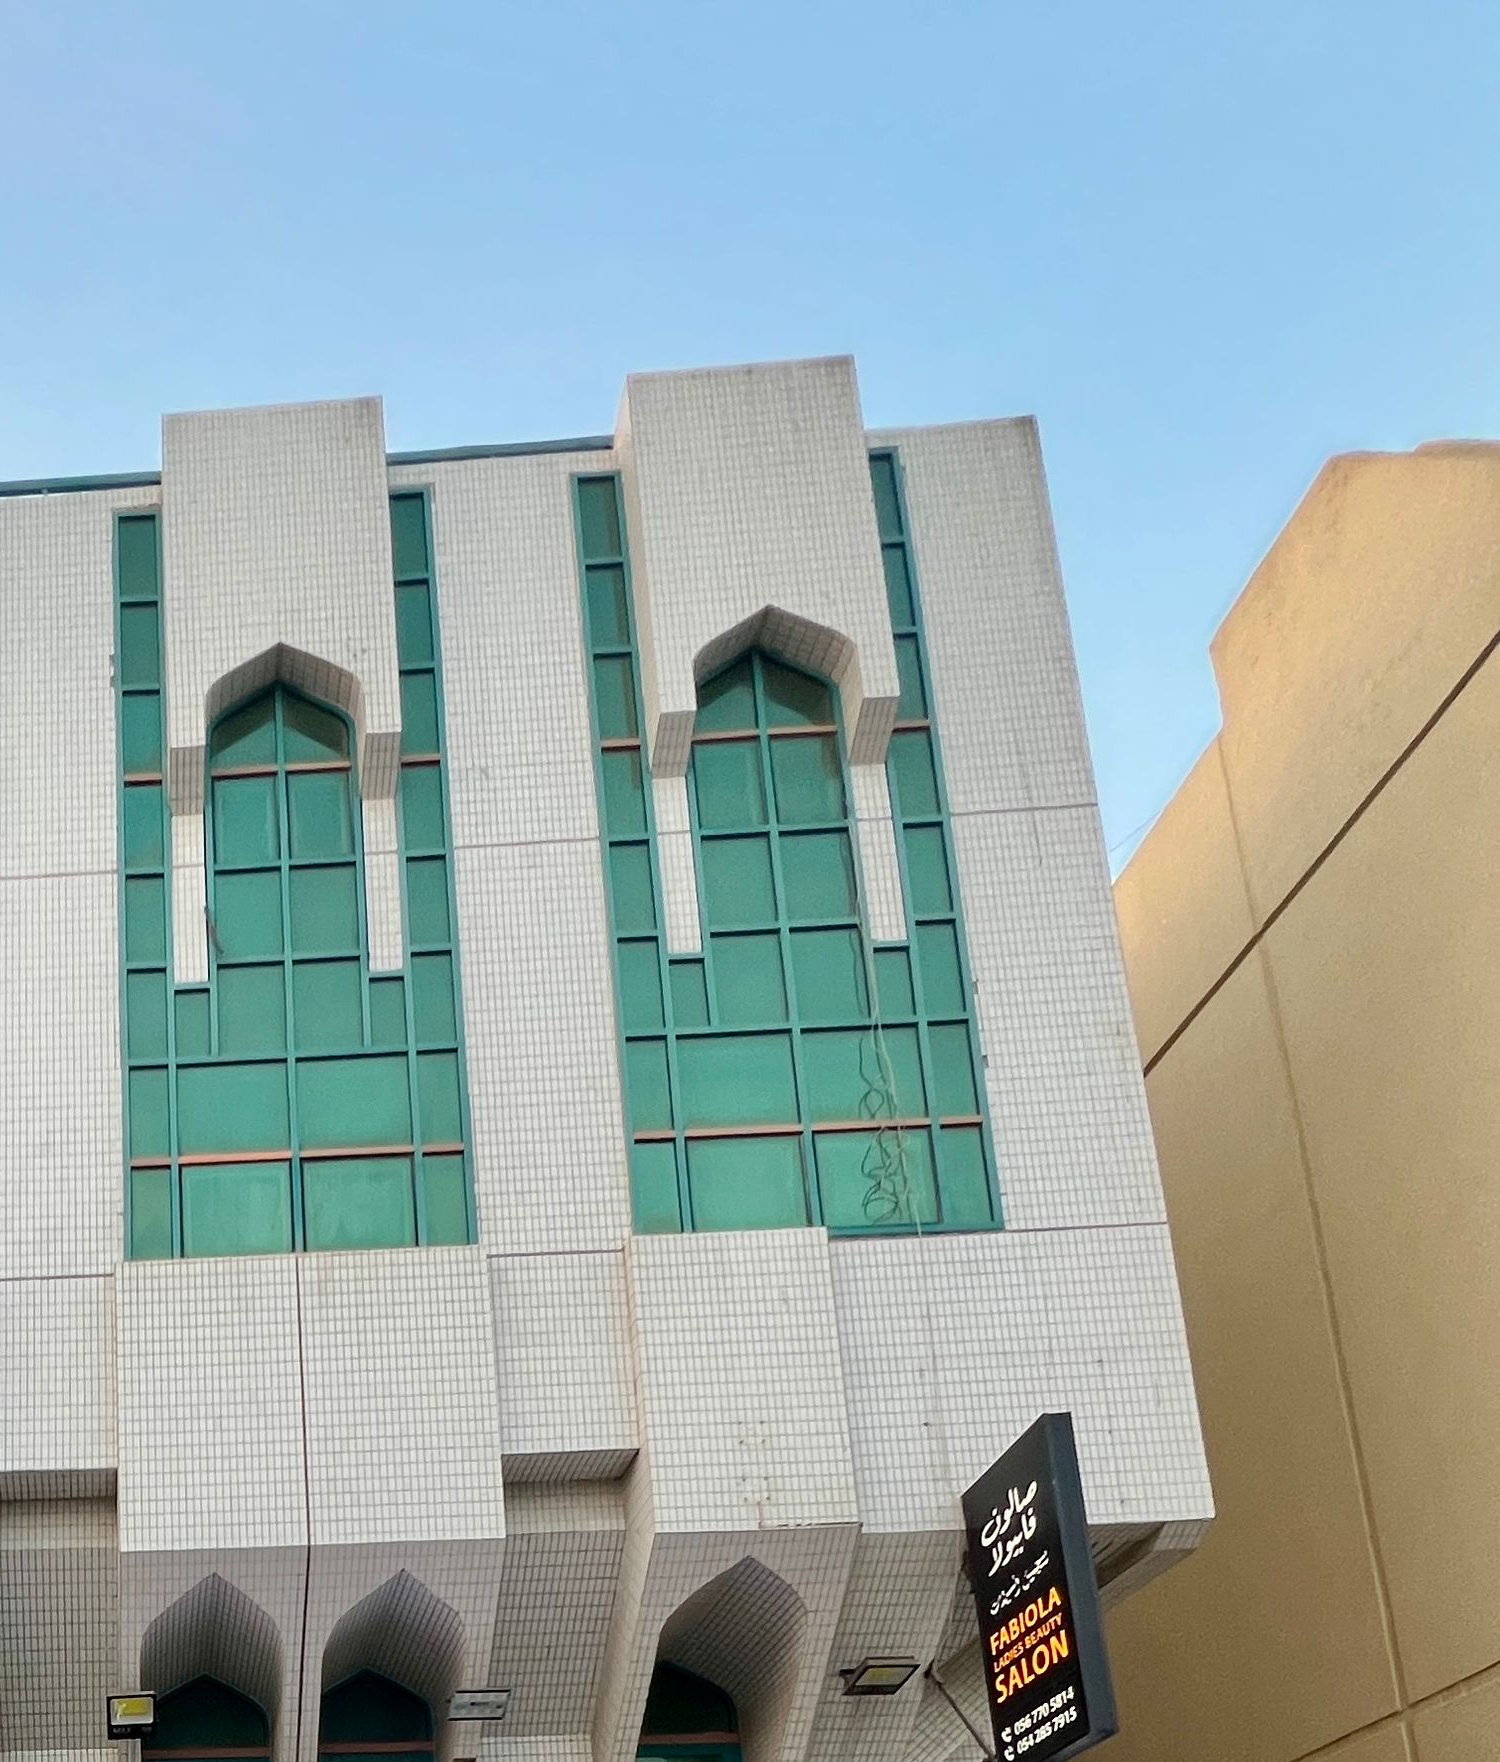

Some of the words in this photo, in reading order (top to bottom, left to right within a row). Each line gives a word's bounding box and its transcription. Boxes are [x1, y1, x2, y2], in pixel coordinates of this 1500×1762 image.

[981, 1480, 1037, 1547] صالون
[990, 1586, 1062, 1656] FABIOLA
[994, 1641, 1025, 1673] LADIES
[1023, 1612, 1062, 1649] BEAUTY
[995, 1629, 1070, 1704] SALON
